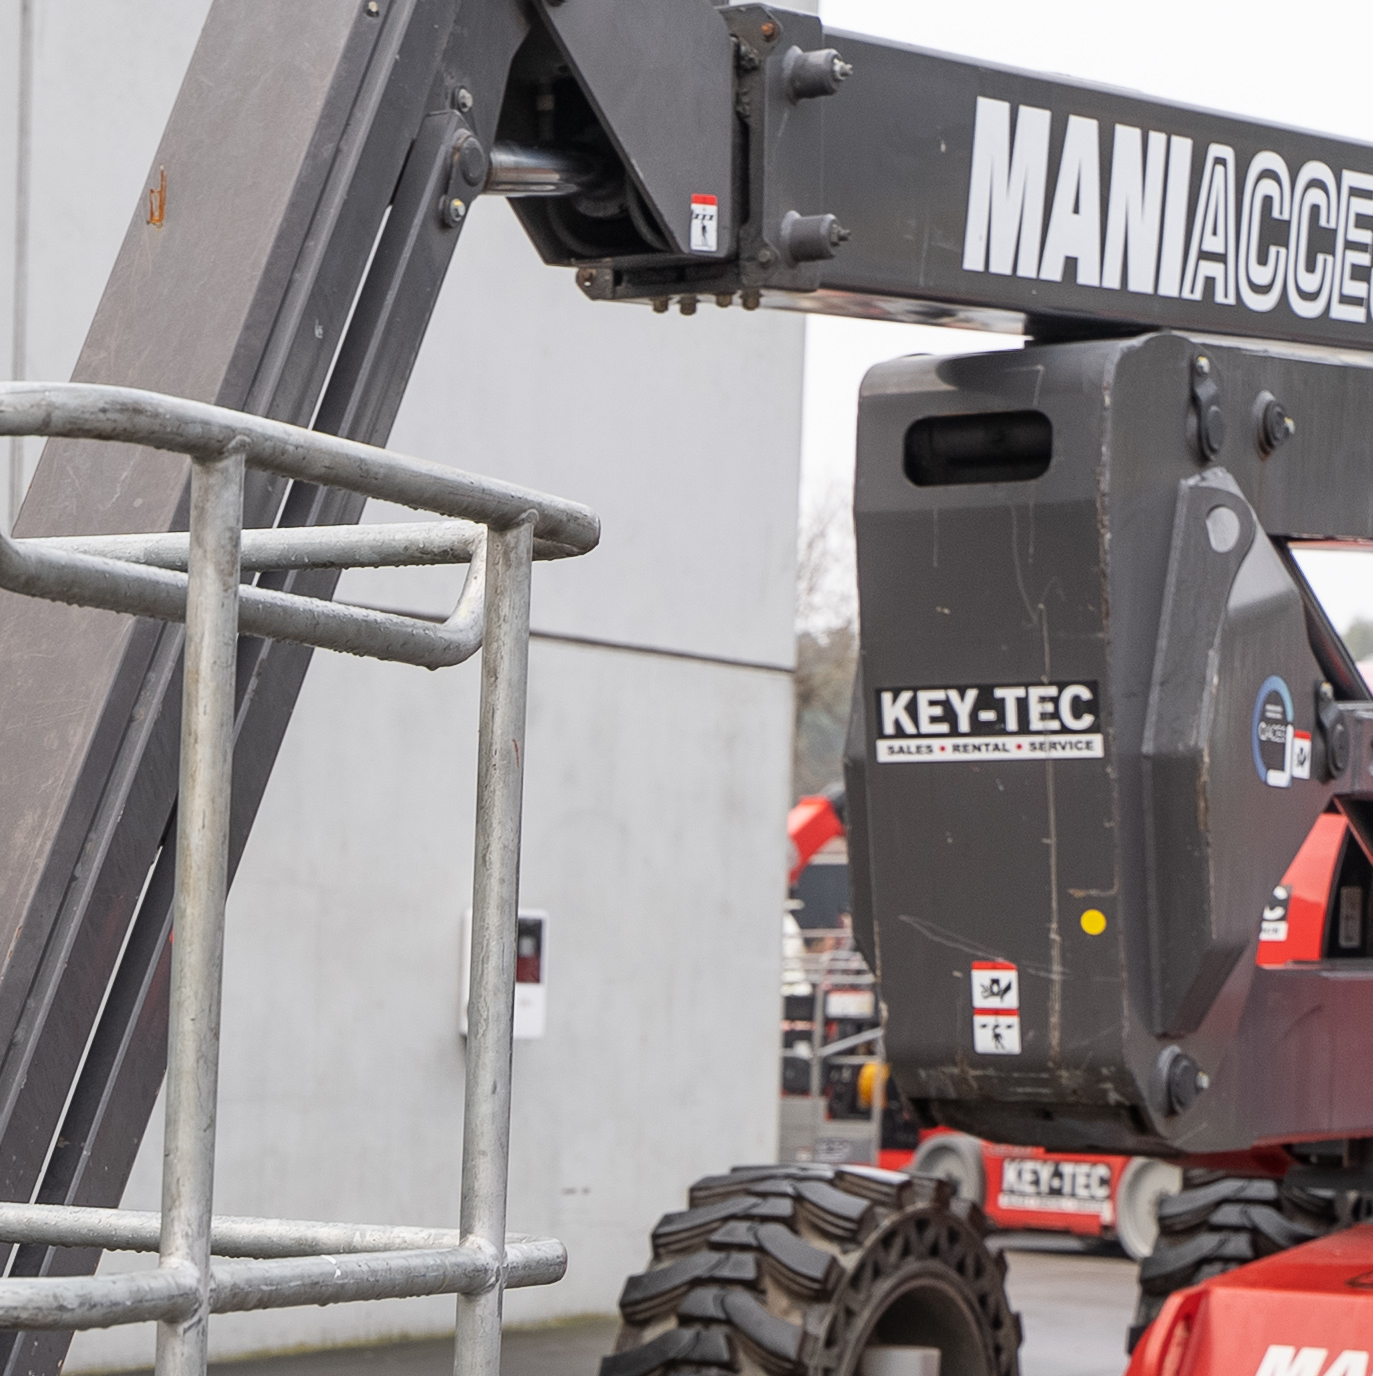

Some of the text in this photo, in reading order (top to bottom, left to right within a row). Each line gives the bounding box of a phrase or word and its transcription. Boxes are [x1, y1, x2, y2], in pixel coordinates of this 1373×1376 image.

[962, 96, 1373, 323] MANIACCE
[880, 684, 1096, 736] KEY-TEC
[886, 740, 1095, 755] SALES RENTAL SERVICE
[1002, 1158, 1111, 1198] KEY-TEC
